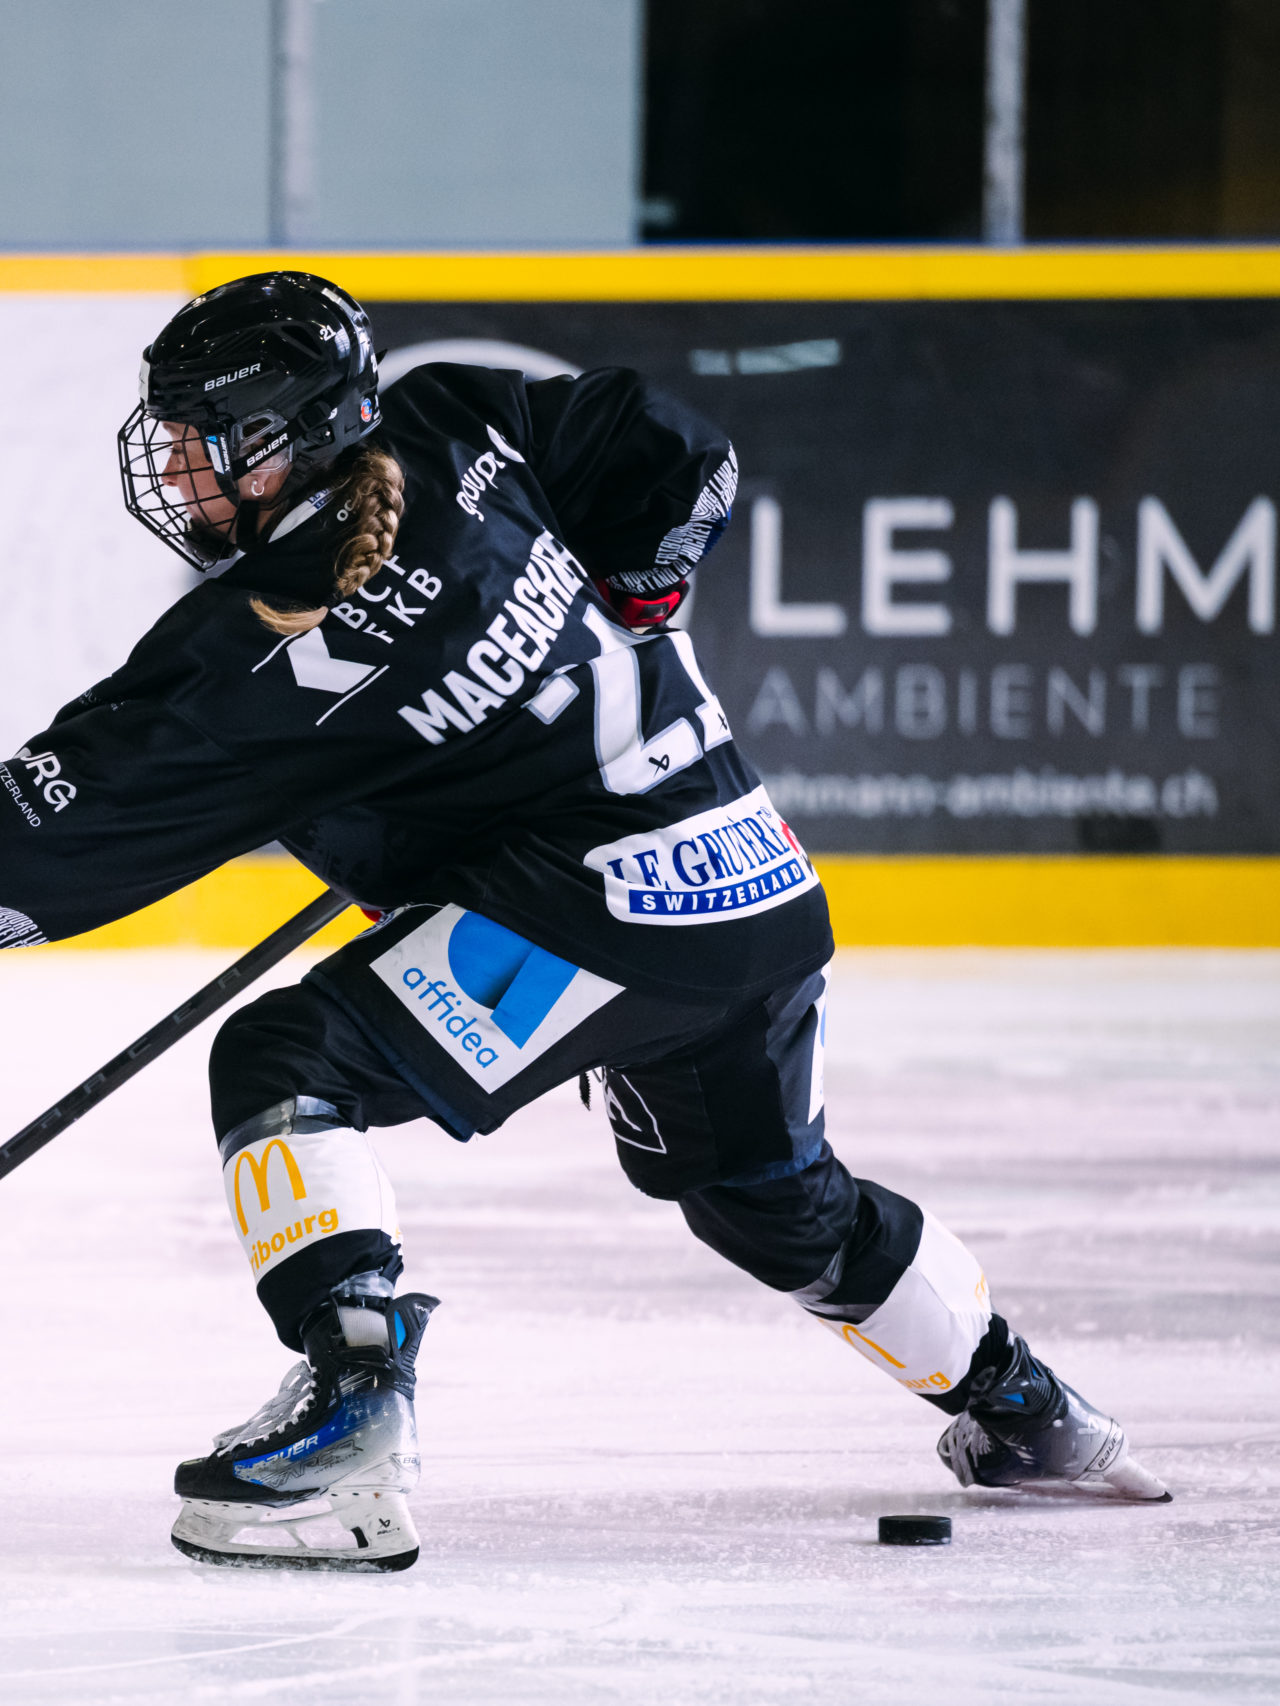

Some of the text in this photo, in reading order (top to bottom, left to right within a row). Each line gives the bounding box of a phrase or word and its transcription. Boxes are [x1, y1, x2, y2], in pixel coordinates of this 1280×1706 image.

[204, 362, 262, 393] BAUER
[246, 433, 289, 468] BAUER
[751, 495, 1277, 639] LEHM
[362, 568, 442, 645] FKB
[747, 664, 1220, 740] AMBIENTE
[642, 865, 803, 912] SWITZERLAND
[402, 966, 500, 1069] affidea
